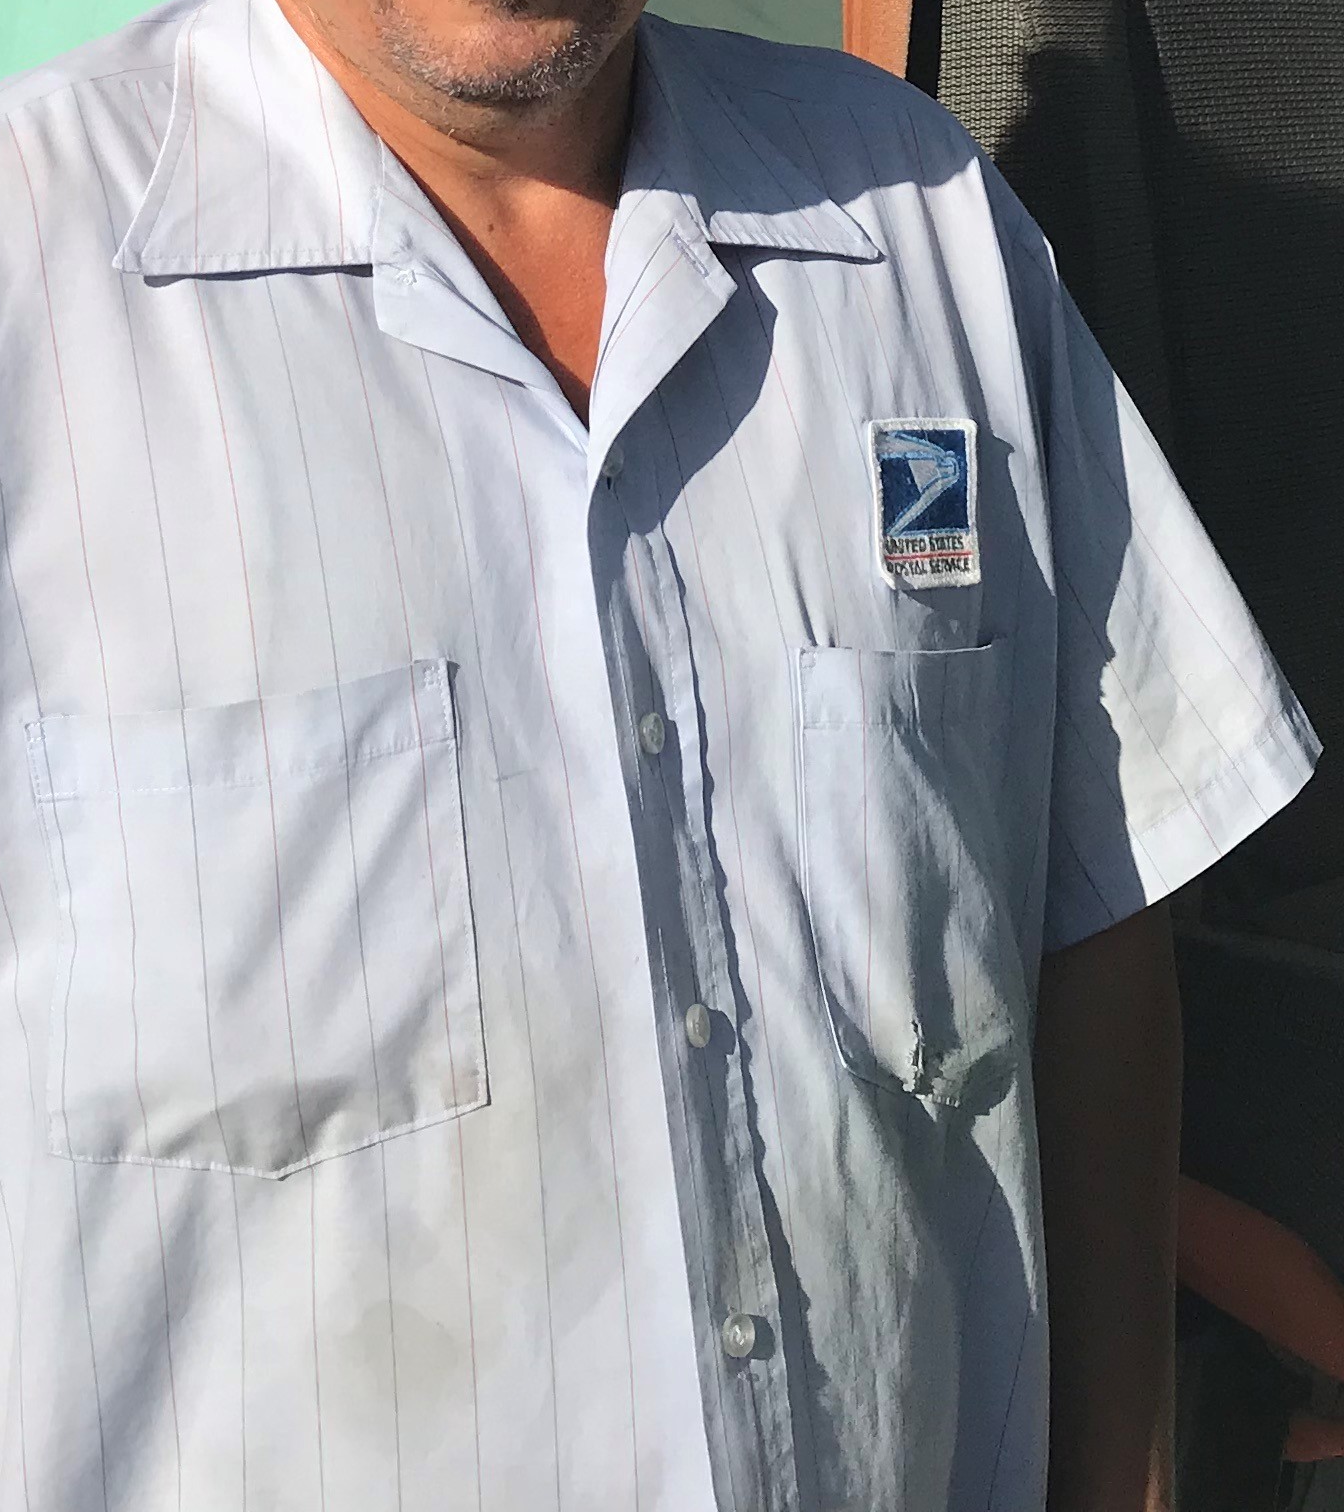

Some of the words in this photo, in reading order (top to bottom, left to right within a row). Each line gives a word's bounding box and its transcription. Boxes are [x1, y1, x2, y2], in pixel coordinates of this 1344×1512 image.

[884, 537, 927, 555] UNITED
[929, 534, 965, 552] STATES
[886, 560, 928, 576] POSTAL
[929, 556, 971, 574] SERVICE
